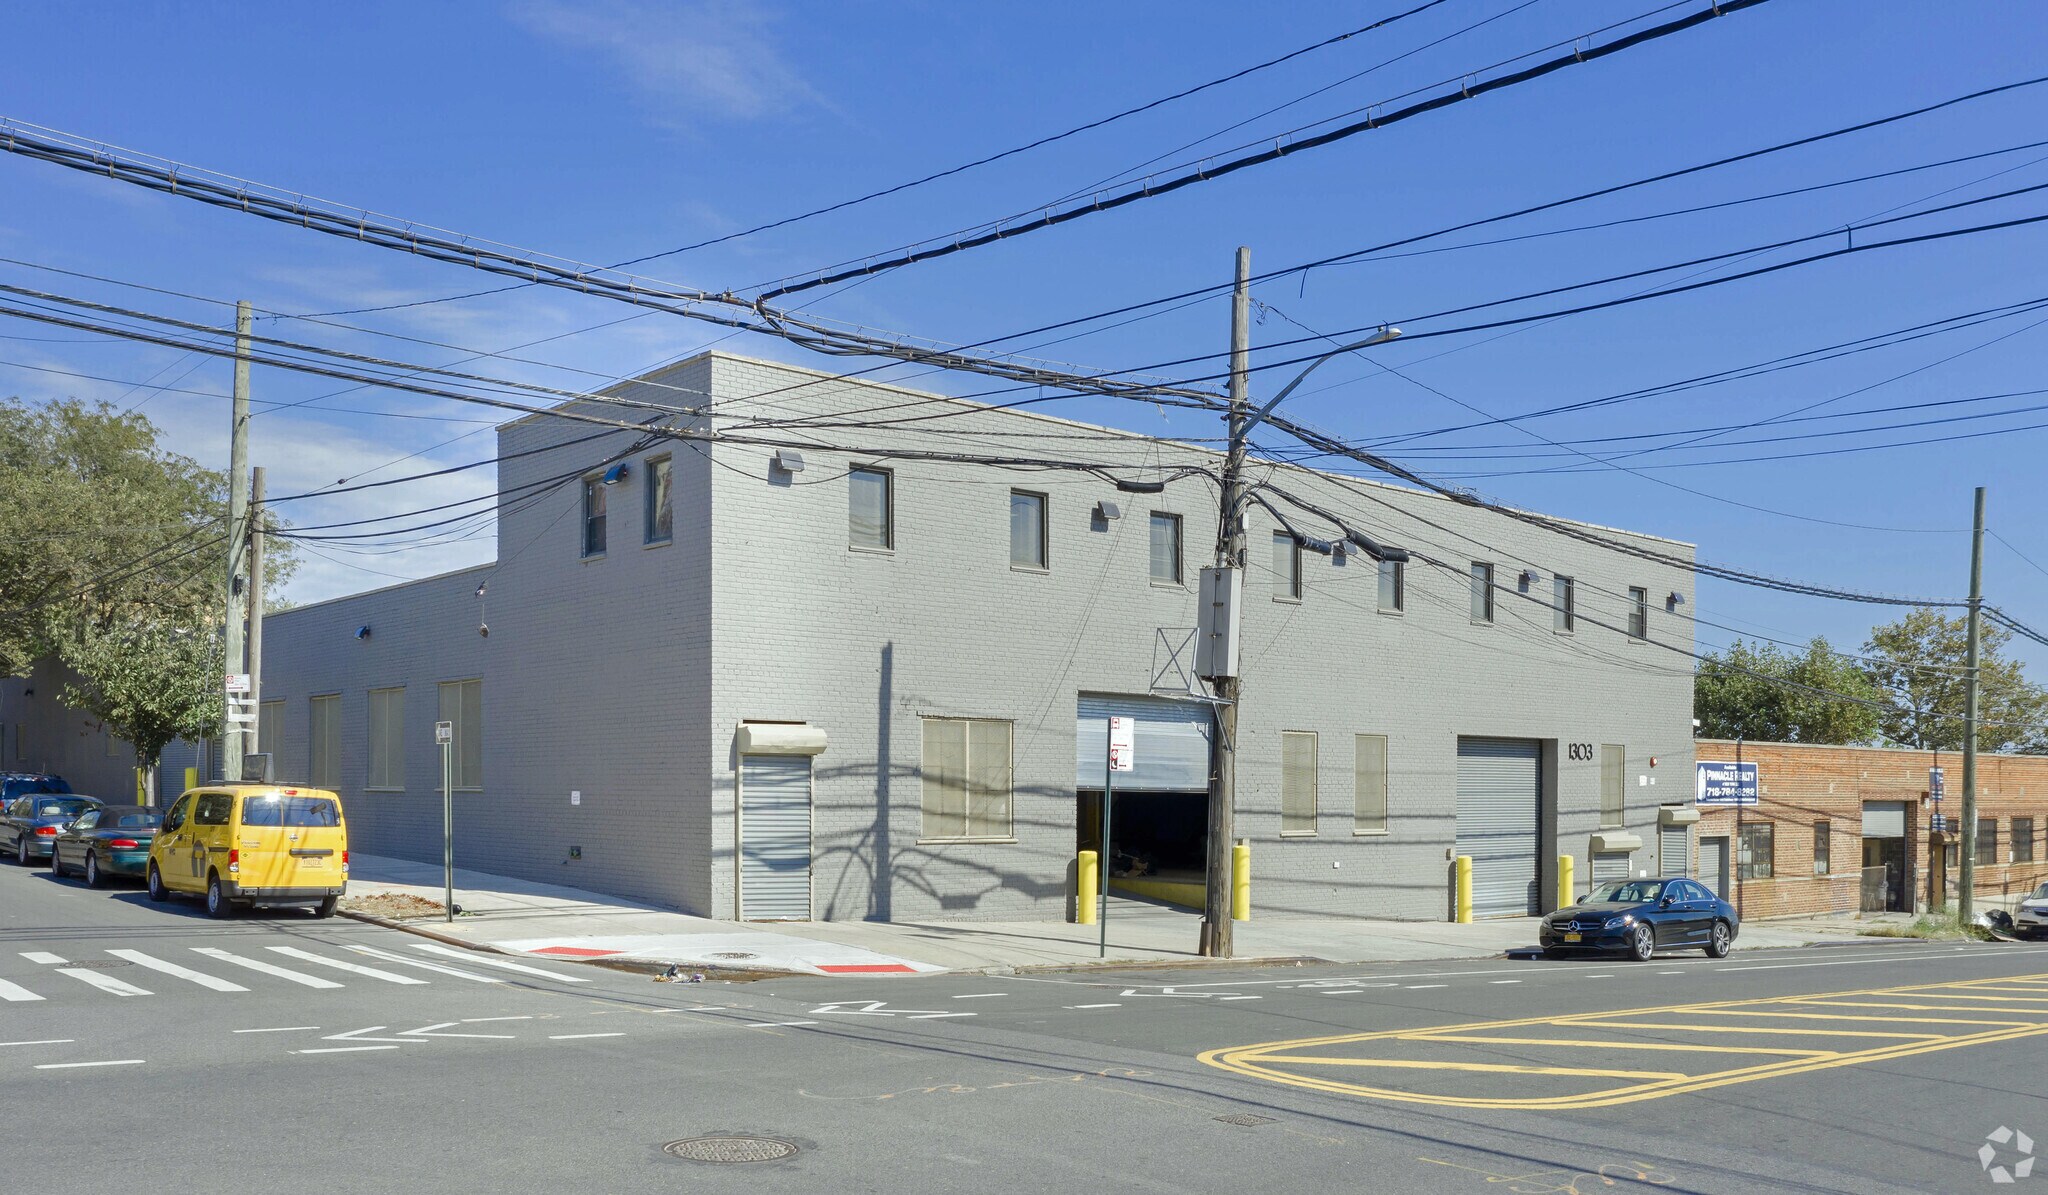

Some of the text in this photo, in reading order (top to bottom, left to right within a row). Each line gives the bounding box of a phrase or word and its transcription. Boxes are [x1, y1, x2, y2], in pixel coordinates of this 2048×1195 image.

[1569, 743, 1593, 761] 1303
[1706, 770, 1755, 782] PINNACLE REALTY
[1706, 787, 1755, 797] 718-784-8282
